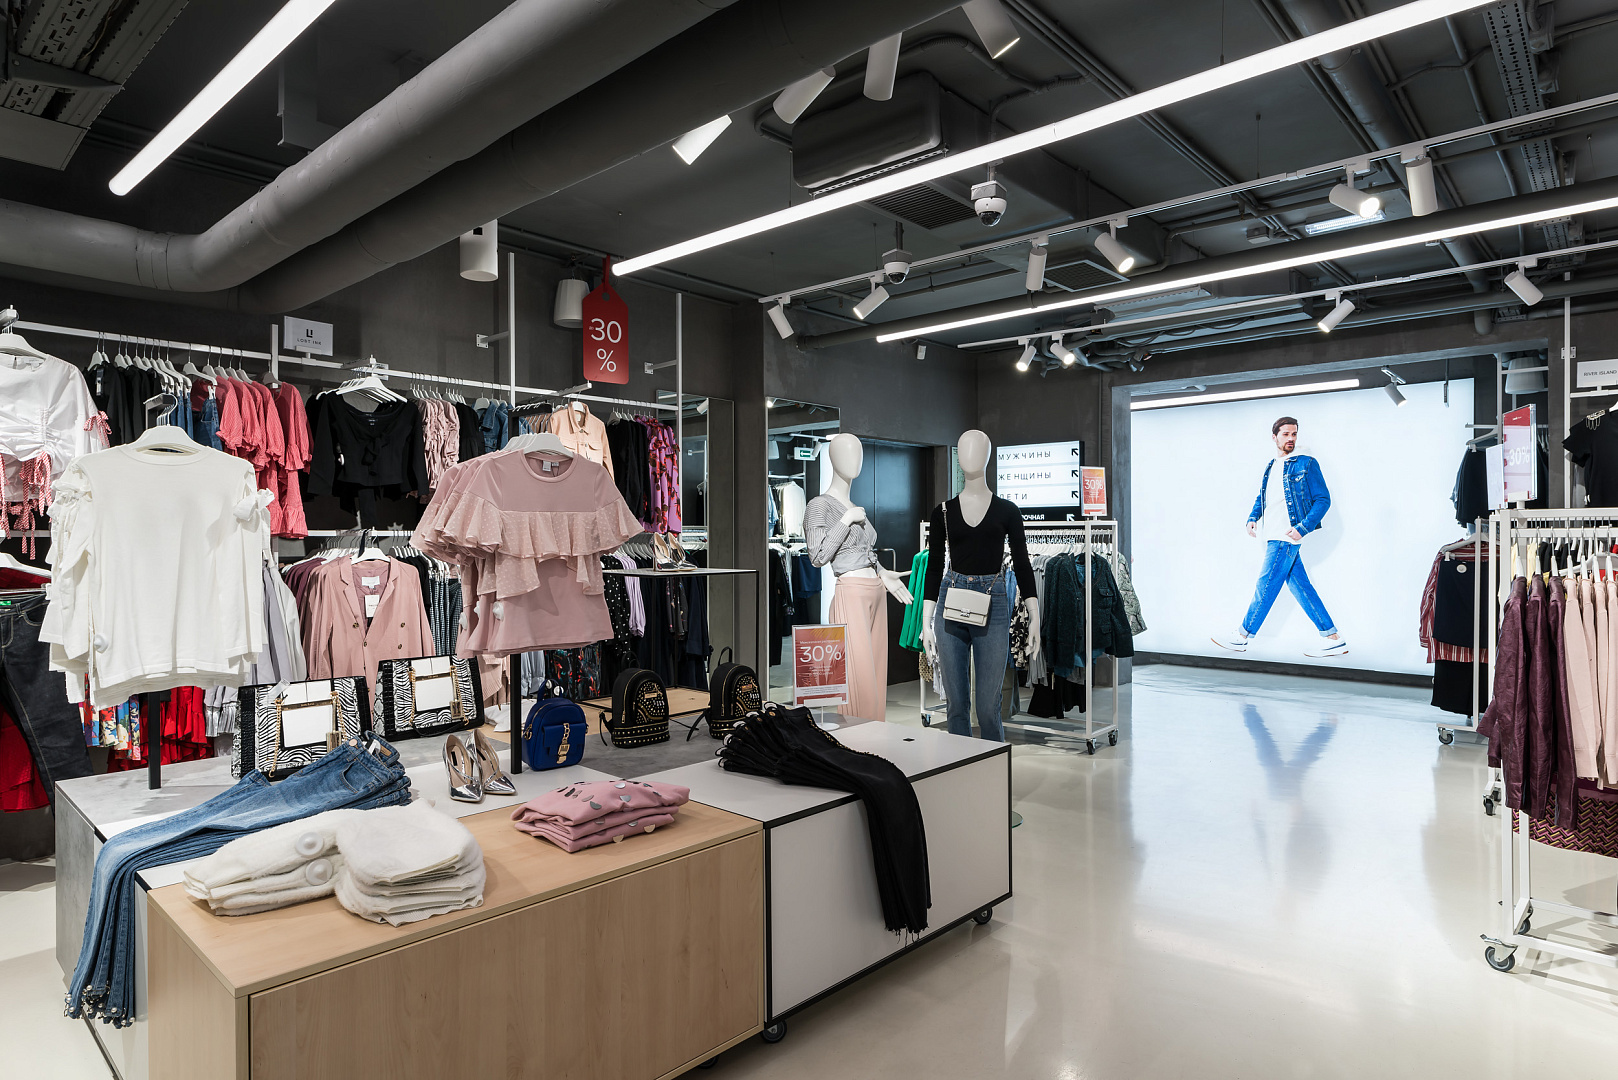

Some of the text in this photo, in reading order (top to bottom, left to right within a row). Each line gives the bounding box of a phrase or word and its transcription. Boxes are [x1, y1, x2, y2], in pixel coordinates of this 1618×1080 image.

[590, 318, 622, 344] 30
[596, 348, 617, 372] %
[998, 451, 1051, 460] МУЖЧИНЫ
[998, 472, 1052, 481] ЖЕНЩИНЫ
[1084, 479, 1104, 490] 30%
[800, 644, 842, 662] 30%
